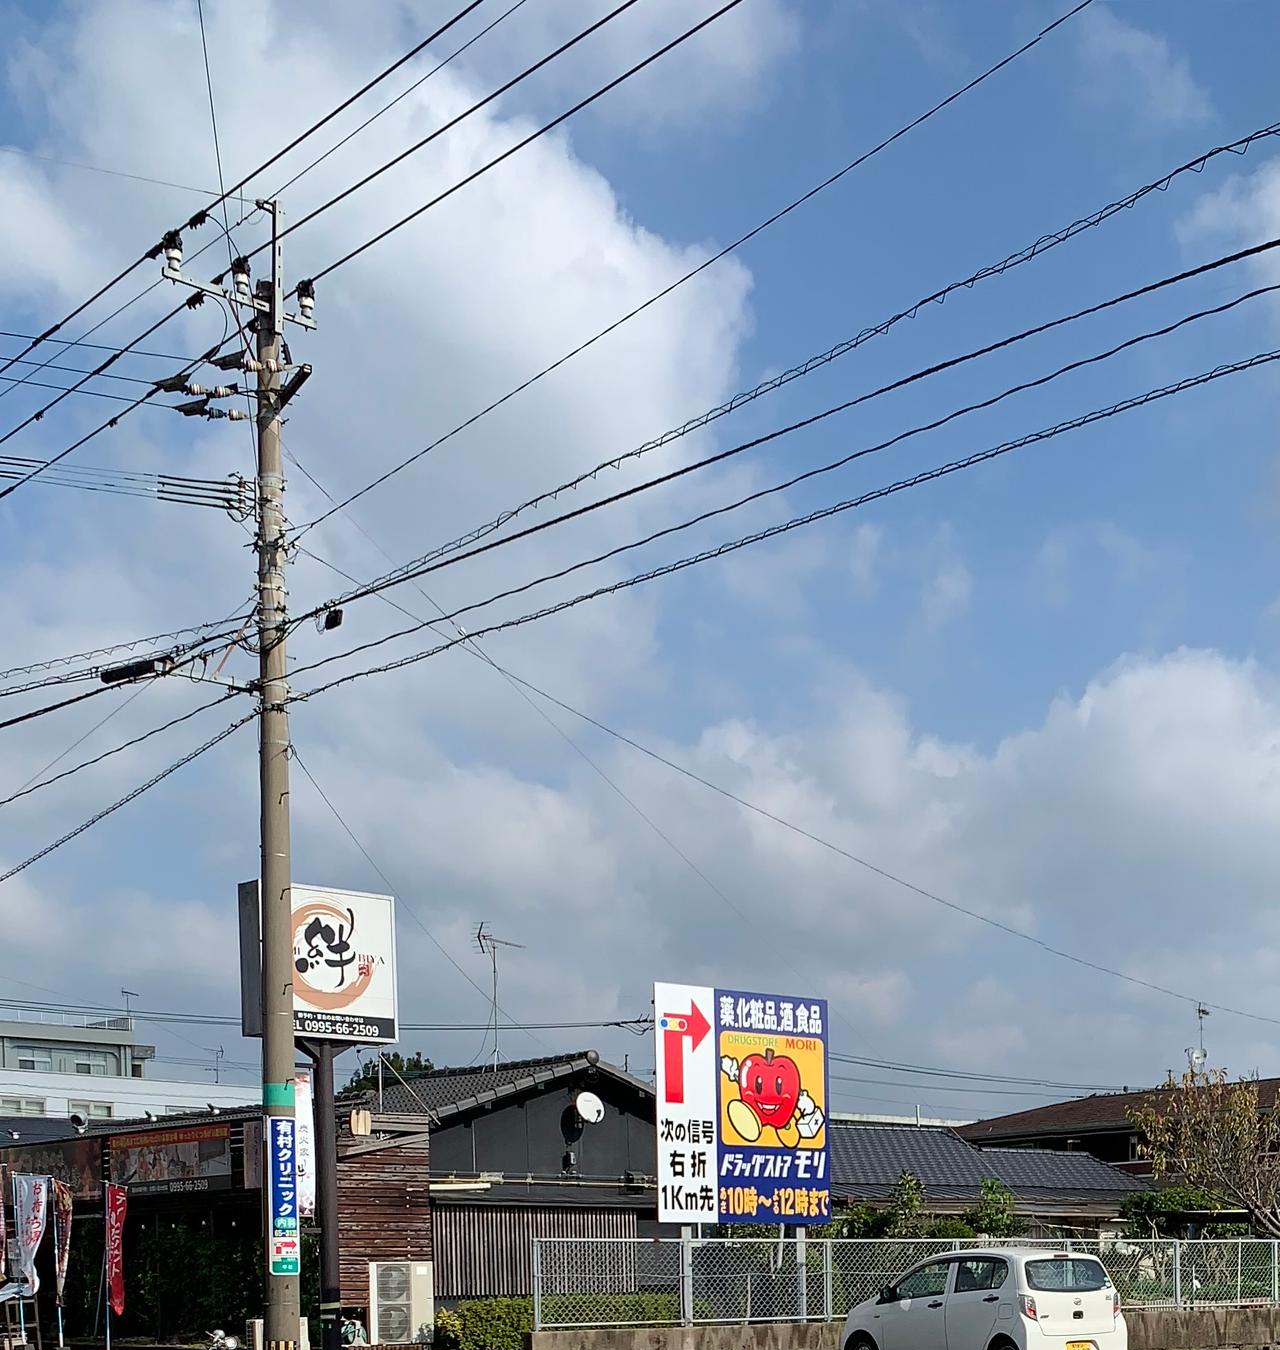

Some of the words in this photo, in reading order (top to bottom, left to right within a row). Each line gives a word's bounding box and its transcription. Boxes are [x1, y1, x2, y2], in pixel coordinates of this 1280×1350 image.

[304, 1020, 380, 1037] 0995-66-2509
[728, 1034, 779, 1048] DRUGSTORE
[785, 1038, 817, 1051] MORI
[660, 1117, 715, 1145] 次の信号
[276, 1120, 295, 1216] 有村クリニック
[669, 1150, 707, 1179] 右折
